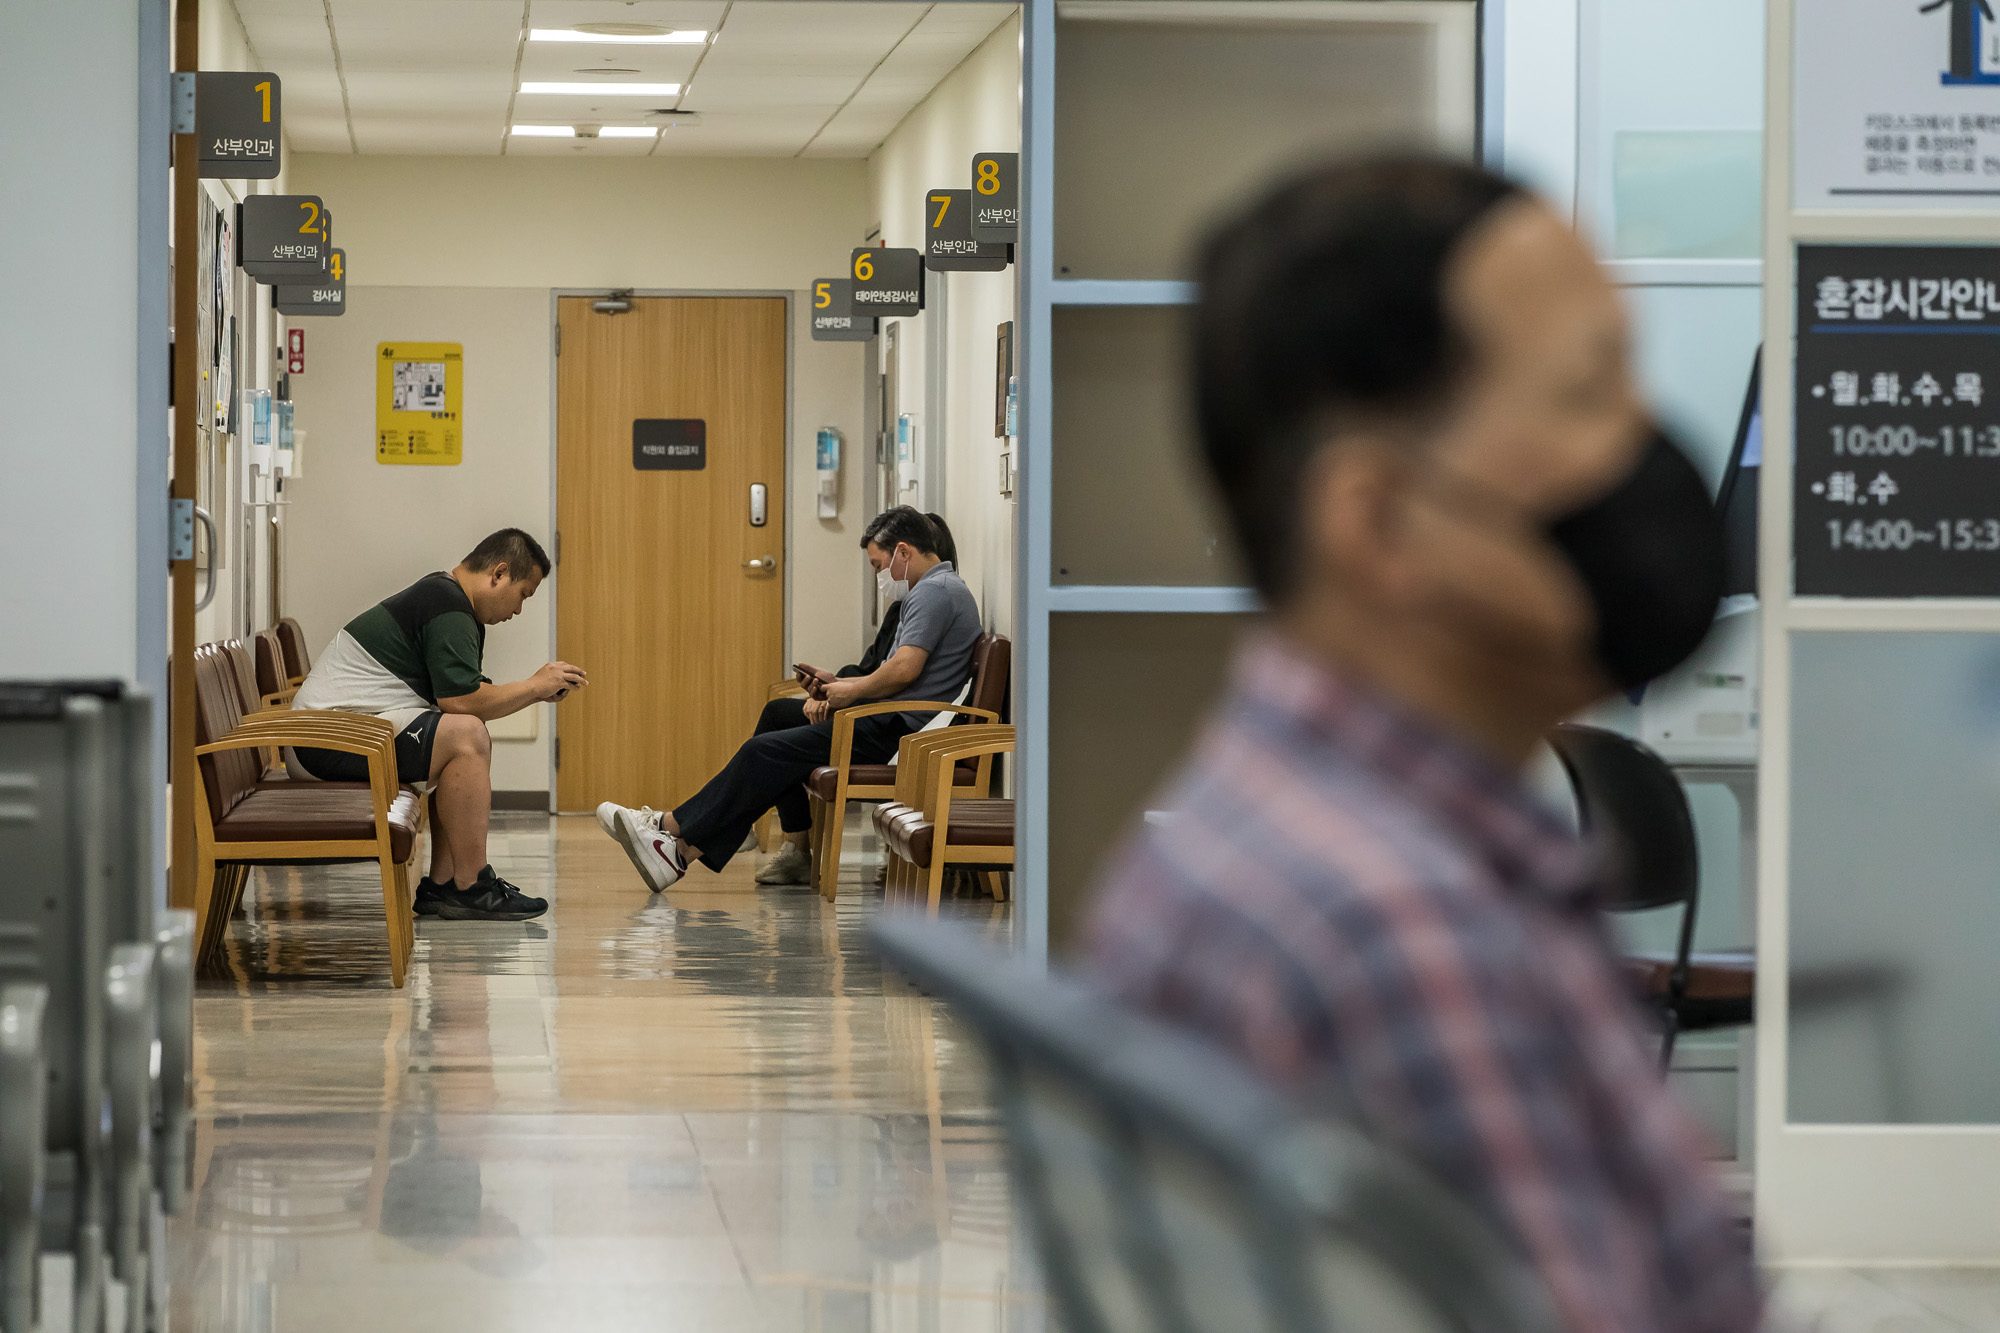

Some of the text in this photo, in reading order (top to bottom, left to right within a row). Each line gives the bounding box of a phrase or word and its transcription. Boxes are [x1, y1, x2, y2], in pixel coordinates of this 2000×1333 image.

[254, 81, 271, 123] 1
[213, 138, 275, 157] 산부인과
[976, 159, 1001, 196] 8
[299, 201, 320, 234] 2
[930, 196, 952, 229] 7
[978, 208, 1019, 224] 산부인
[272, 245, 319, 259] 산부인과
[931, 240, 979, 254] 산부인과
[330, 253, 344, 281] 4
[854, 252, 874, 281] 6
[312, 289, 342, 303] 검사실
[814, 283, 832, 309] 5
[855, 290, 919, 303] 태아안녕검사실
[814, 317, 852, 329] 산부인과
